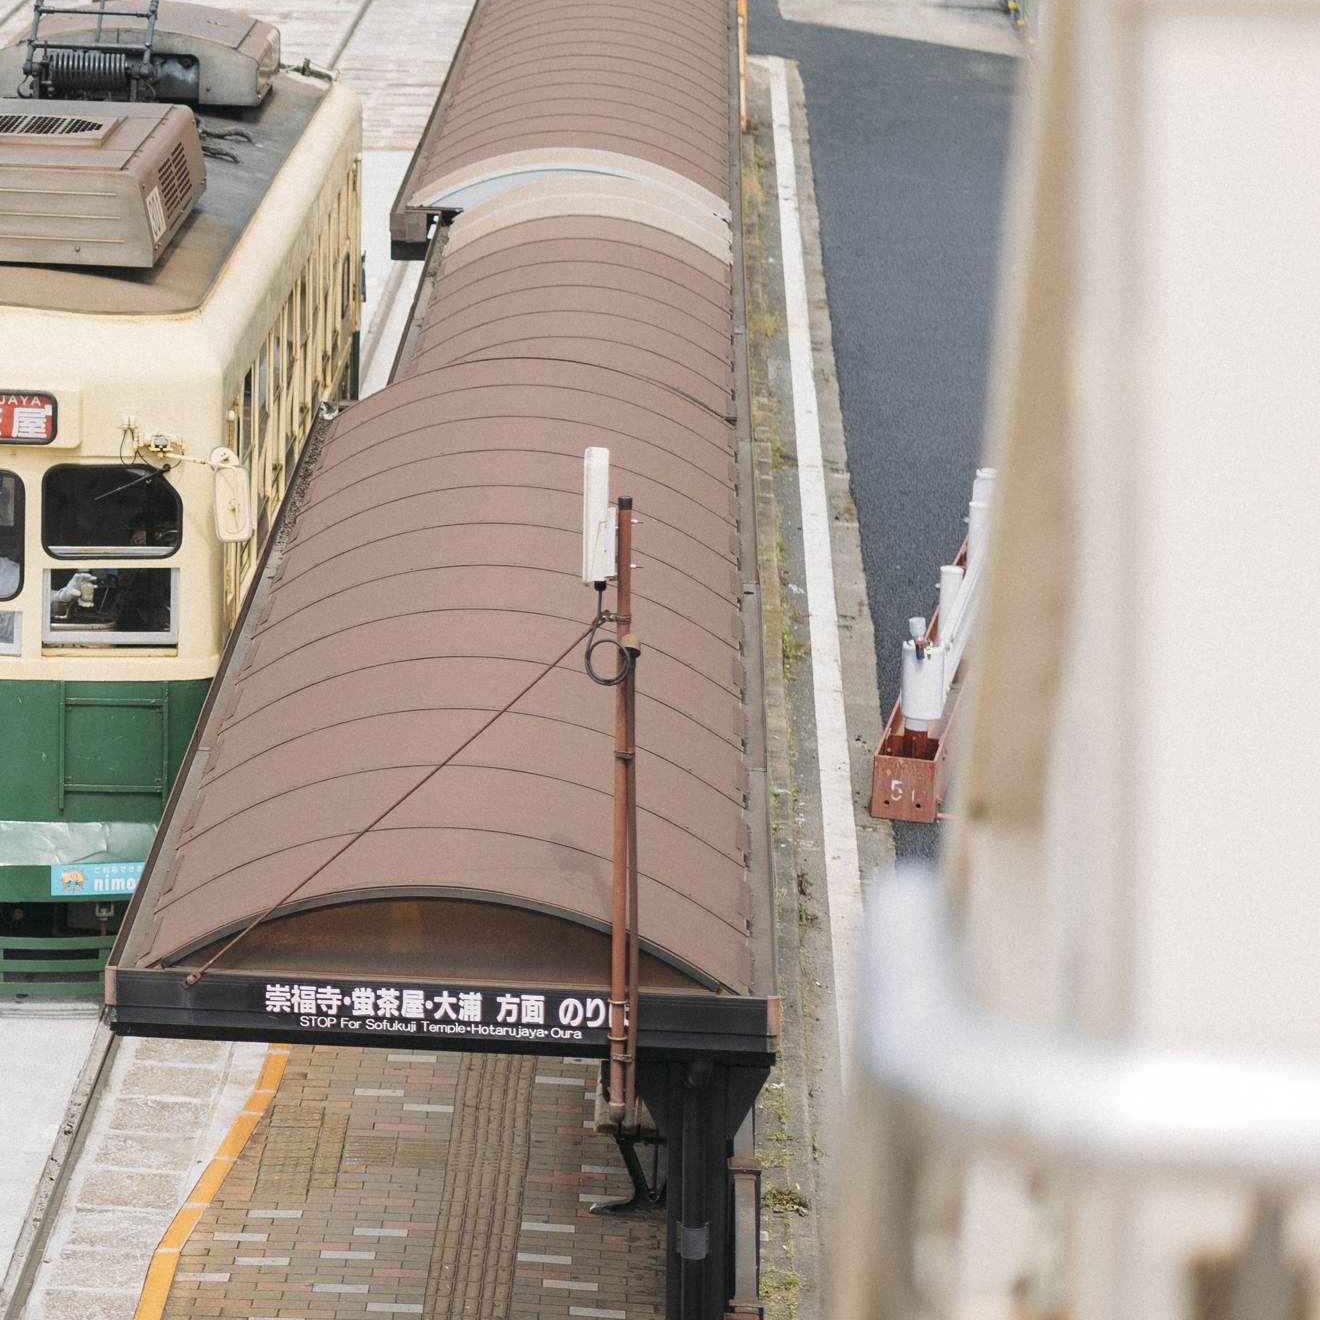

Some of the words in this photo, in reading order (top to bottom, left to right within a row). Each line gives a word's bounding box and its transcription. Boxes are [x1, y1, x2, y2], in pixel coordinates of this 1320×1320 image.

[94, 874, 140, 892] nimo
[496, 994, 546, 1025] 方面
[300, 1016, 337, 1028] STOP
[341, 1017, 362, 1029] For
[365, 1018, 417, 1033] Sofukuji
